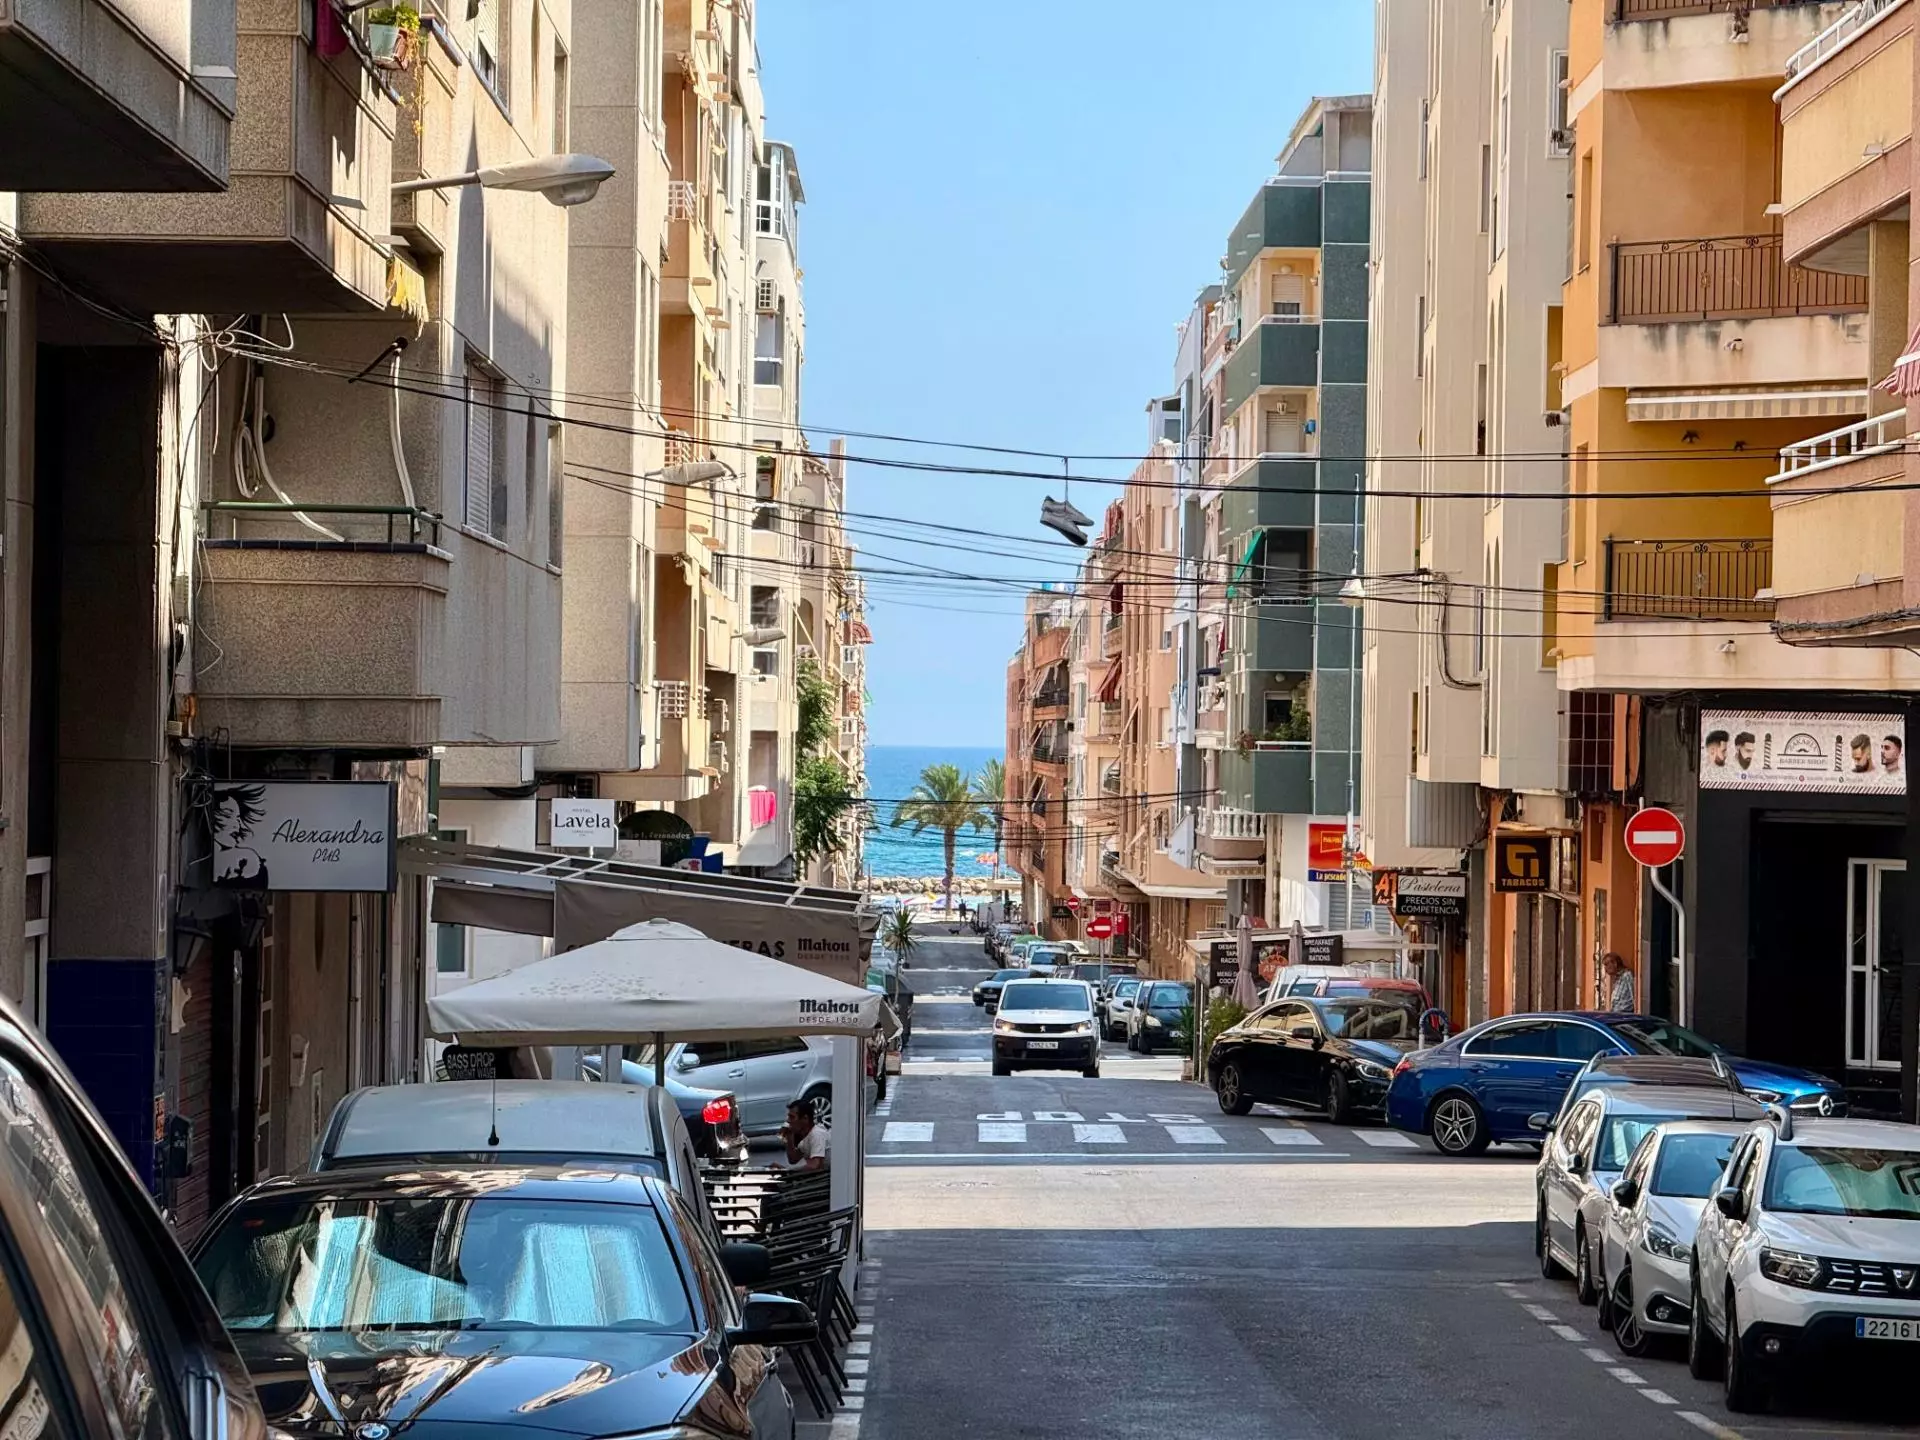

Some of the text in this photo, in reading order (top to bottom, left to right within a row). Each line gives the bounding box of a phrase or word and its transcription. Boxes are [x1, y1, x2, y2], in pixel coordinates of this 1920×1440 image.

[554, 813, 611, 829] Lavela
[271, 818, 385, 844] Alexandra
[312, 848, 341, 863] PUB
[1501, 878, 1545, 887] TABACOS
[1405, 896, 1456, 906] PRECIOS SIN
[1401, 905, 1460, 915] COMPETENCIA
[797, 938, 850, 952] Mahou
[799, 999, 860, 1014] Mahou
[799, 1016, 832, 1024] DESDE
[470, 1051, 495, 1068] DROP
[1868, 1320, 1910, 1338] 2216
